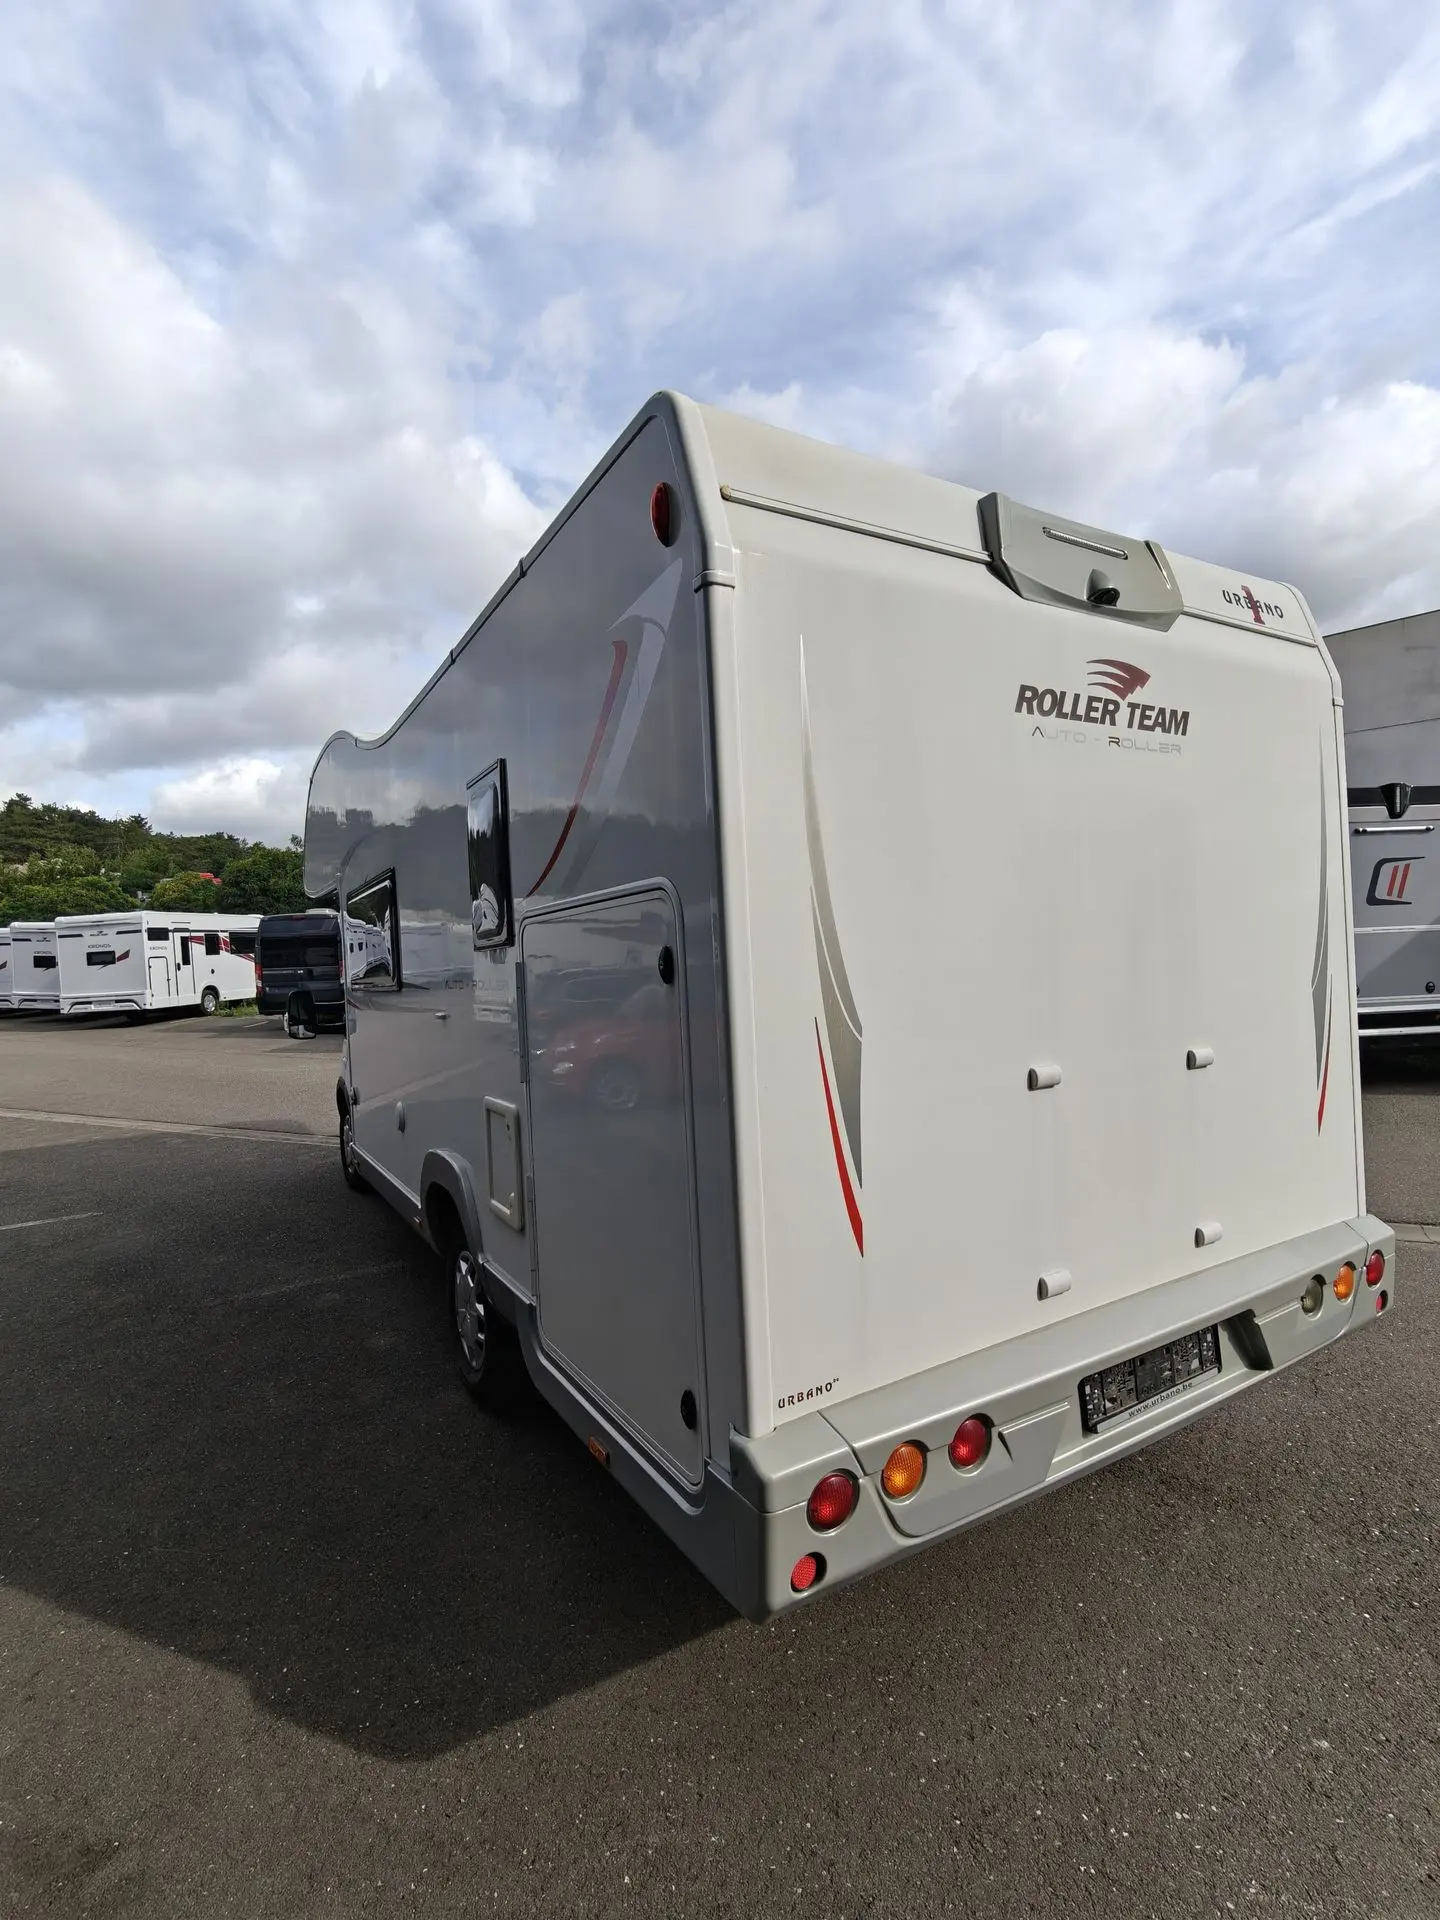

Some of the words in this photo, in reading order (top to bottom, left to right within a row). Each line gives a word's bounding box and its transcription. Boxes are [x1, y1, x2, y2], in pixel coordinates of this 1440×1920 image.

[1014, 684, 1121, 727] ROLLER
[1127, 701, 1191, 737] TEAM
[1031, 726, 1087, 744] AUTO
[1107, 735, 1183, 756] ROLLER
[1128, 1380, 1195, 1418] www.urbano.be
